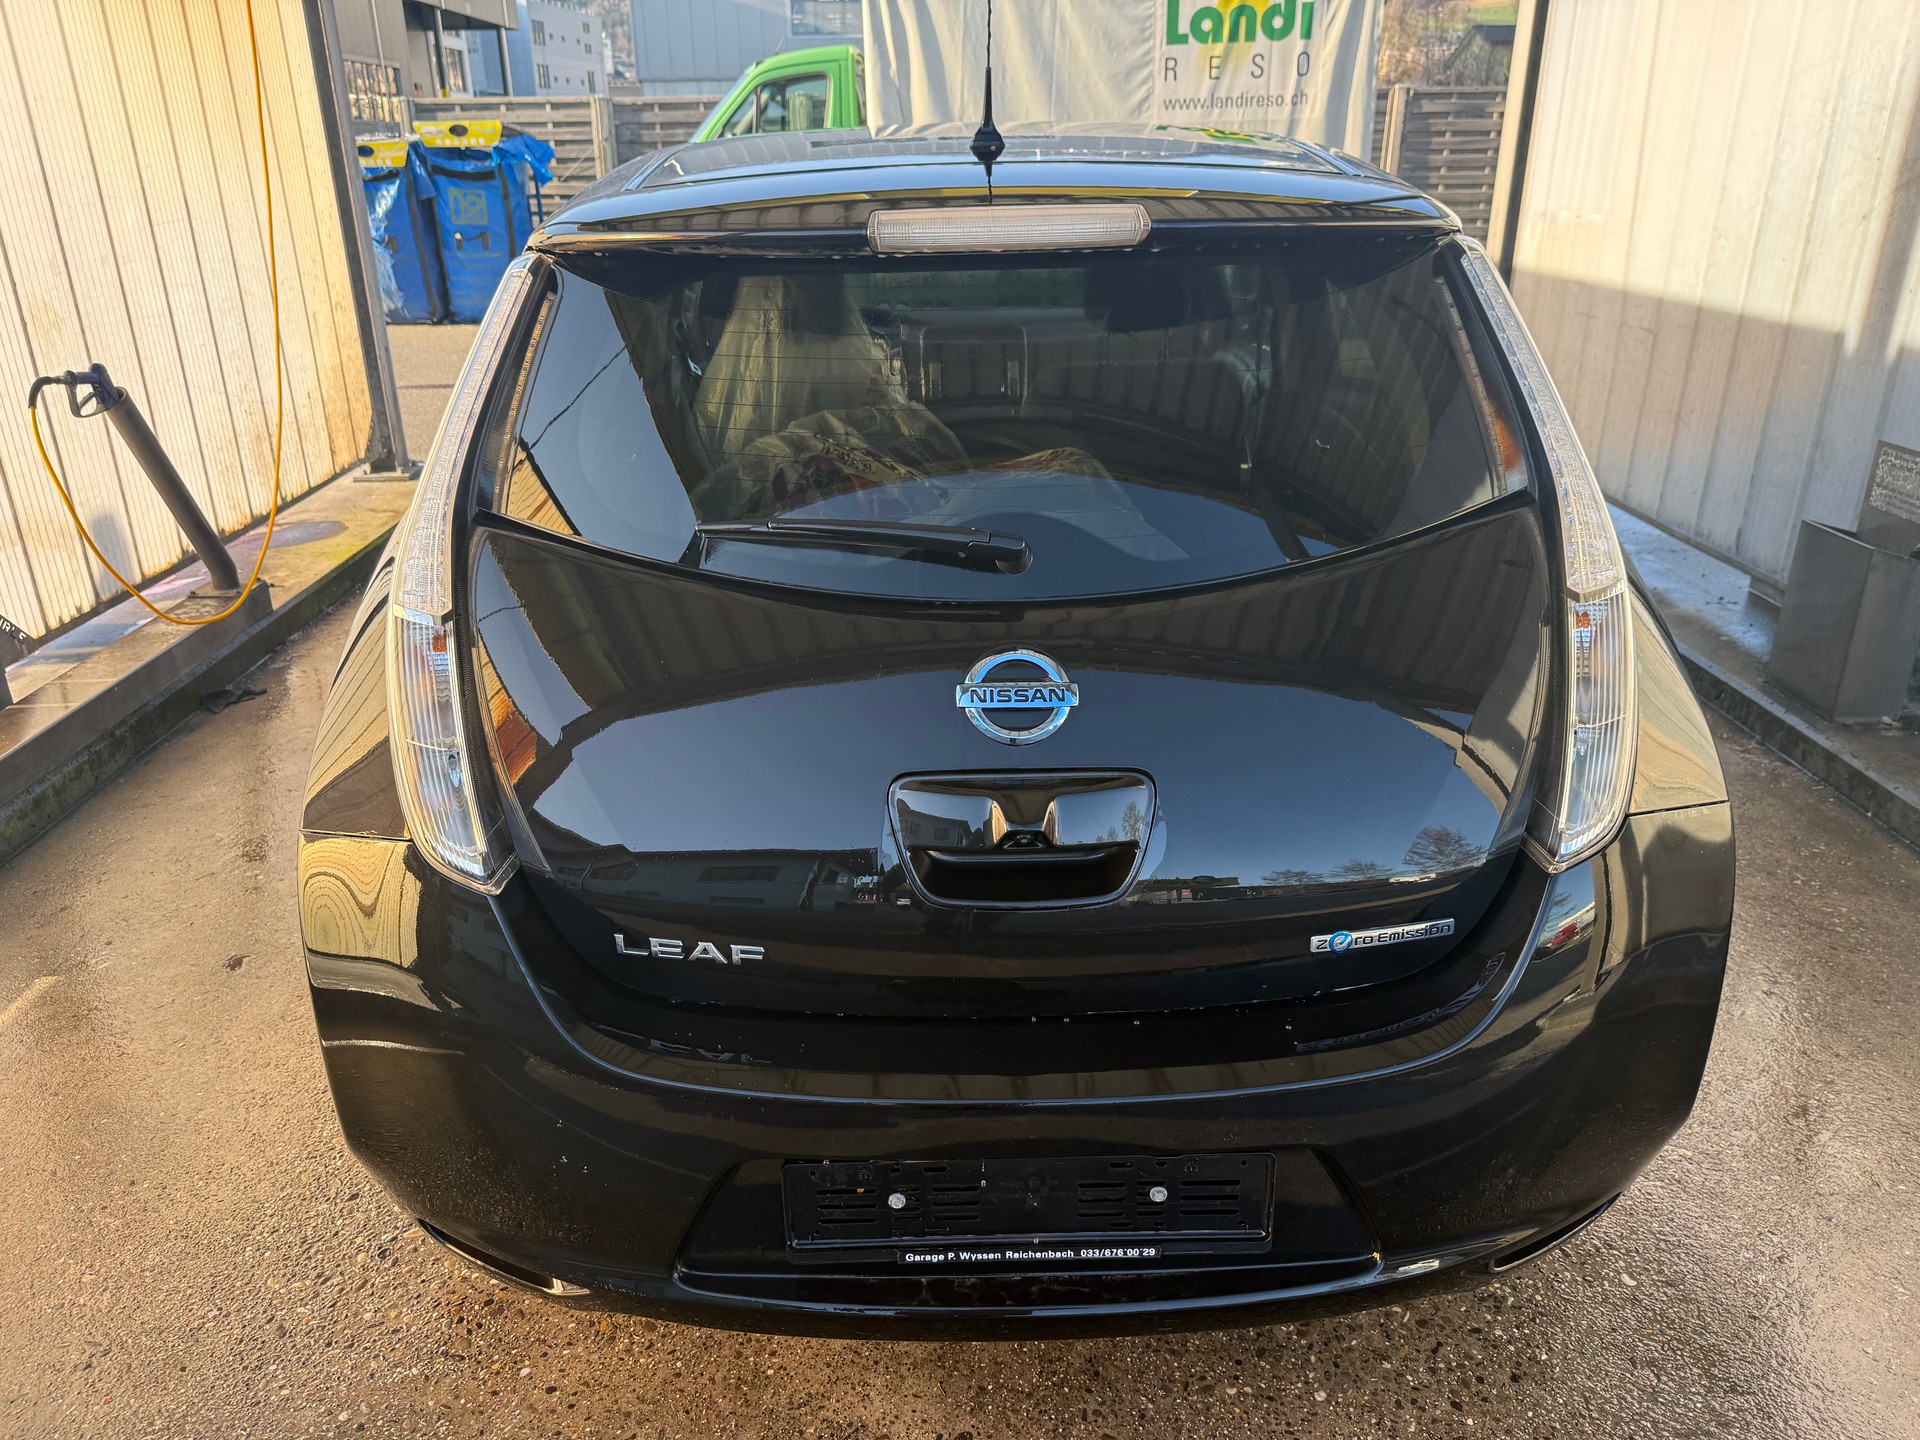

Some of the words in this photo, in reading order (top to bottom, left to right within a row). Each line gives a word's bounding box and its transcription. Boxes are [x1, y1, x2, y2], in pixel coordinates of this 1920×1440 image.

[1166, 0, 1314, 45] Landi
[1164, 51, 1310, 83] RESO
[1163, 91, 1308, 111] www.landireso.ch
[970, 687, 1066, 704] NISSAN
[1377, 924, 1451, 943] Emission
[613, 933, 766, 966] LEAF
[905, 1253, 945, 1262] Garage
[947, 1252, 957, 1260] P.
[959, 1251, 1001, 1261] Wyssen
[1005, 1249, 1074, 1259] Reichenbach
